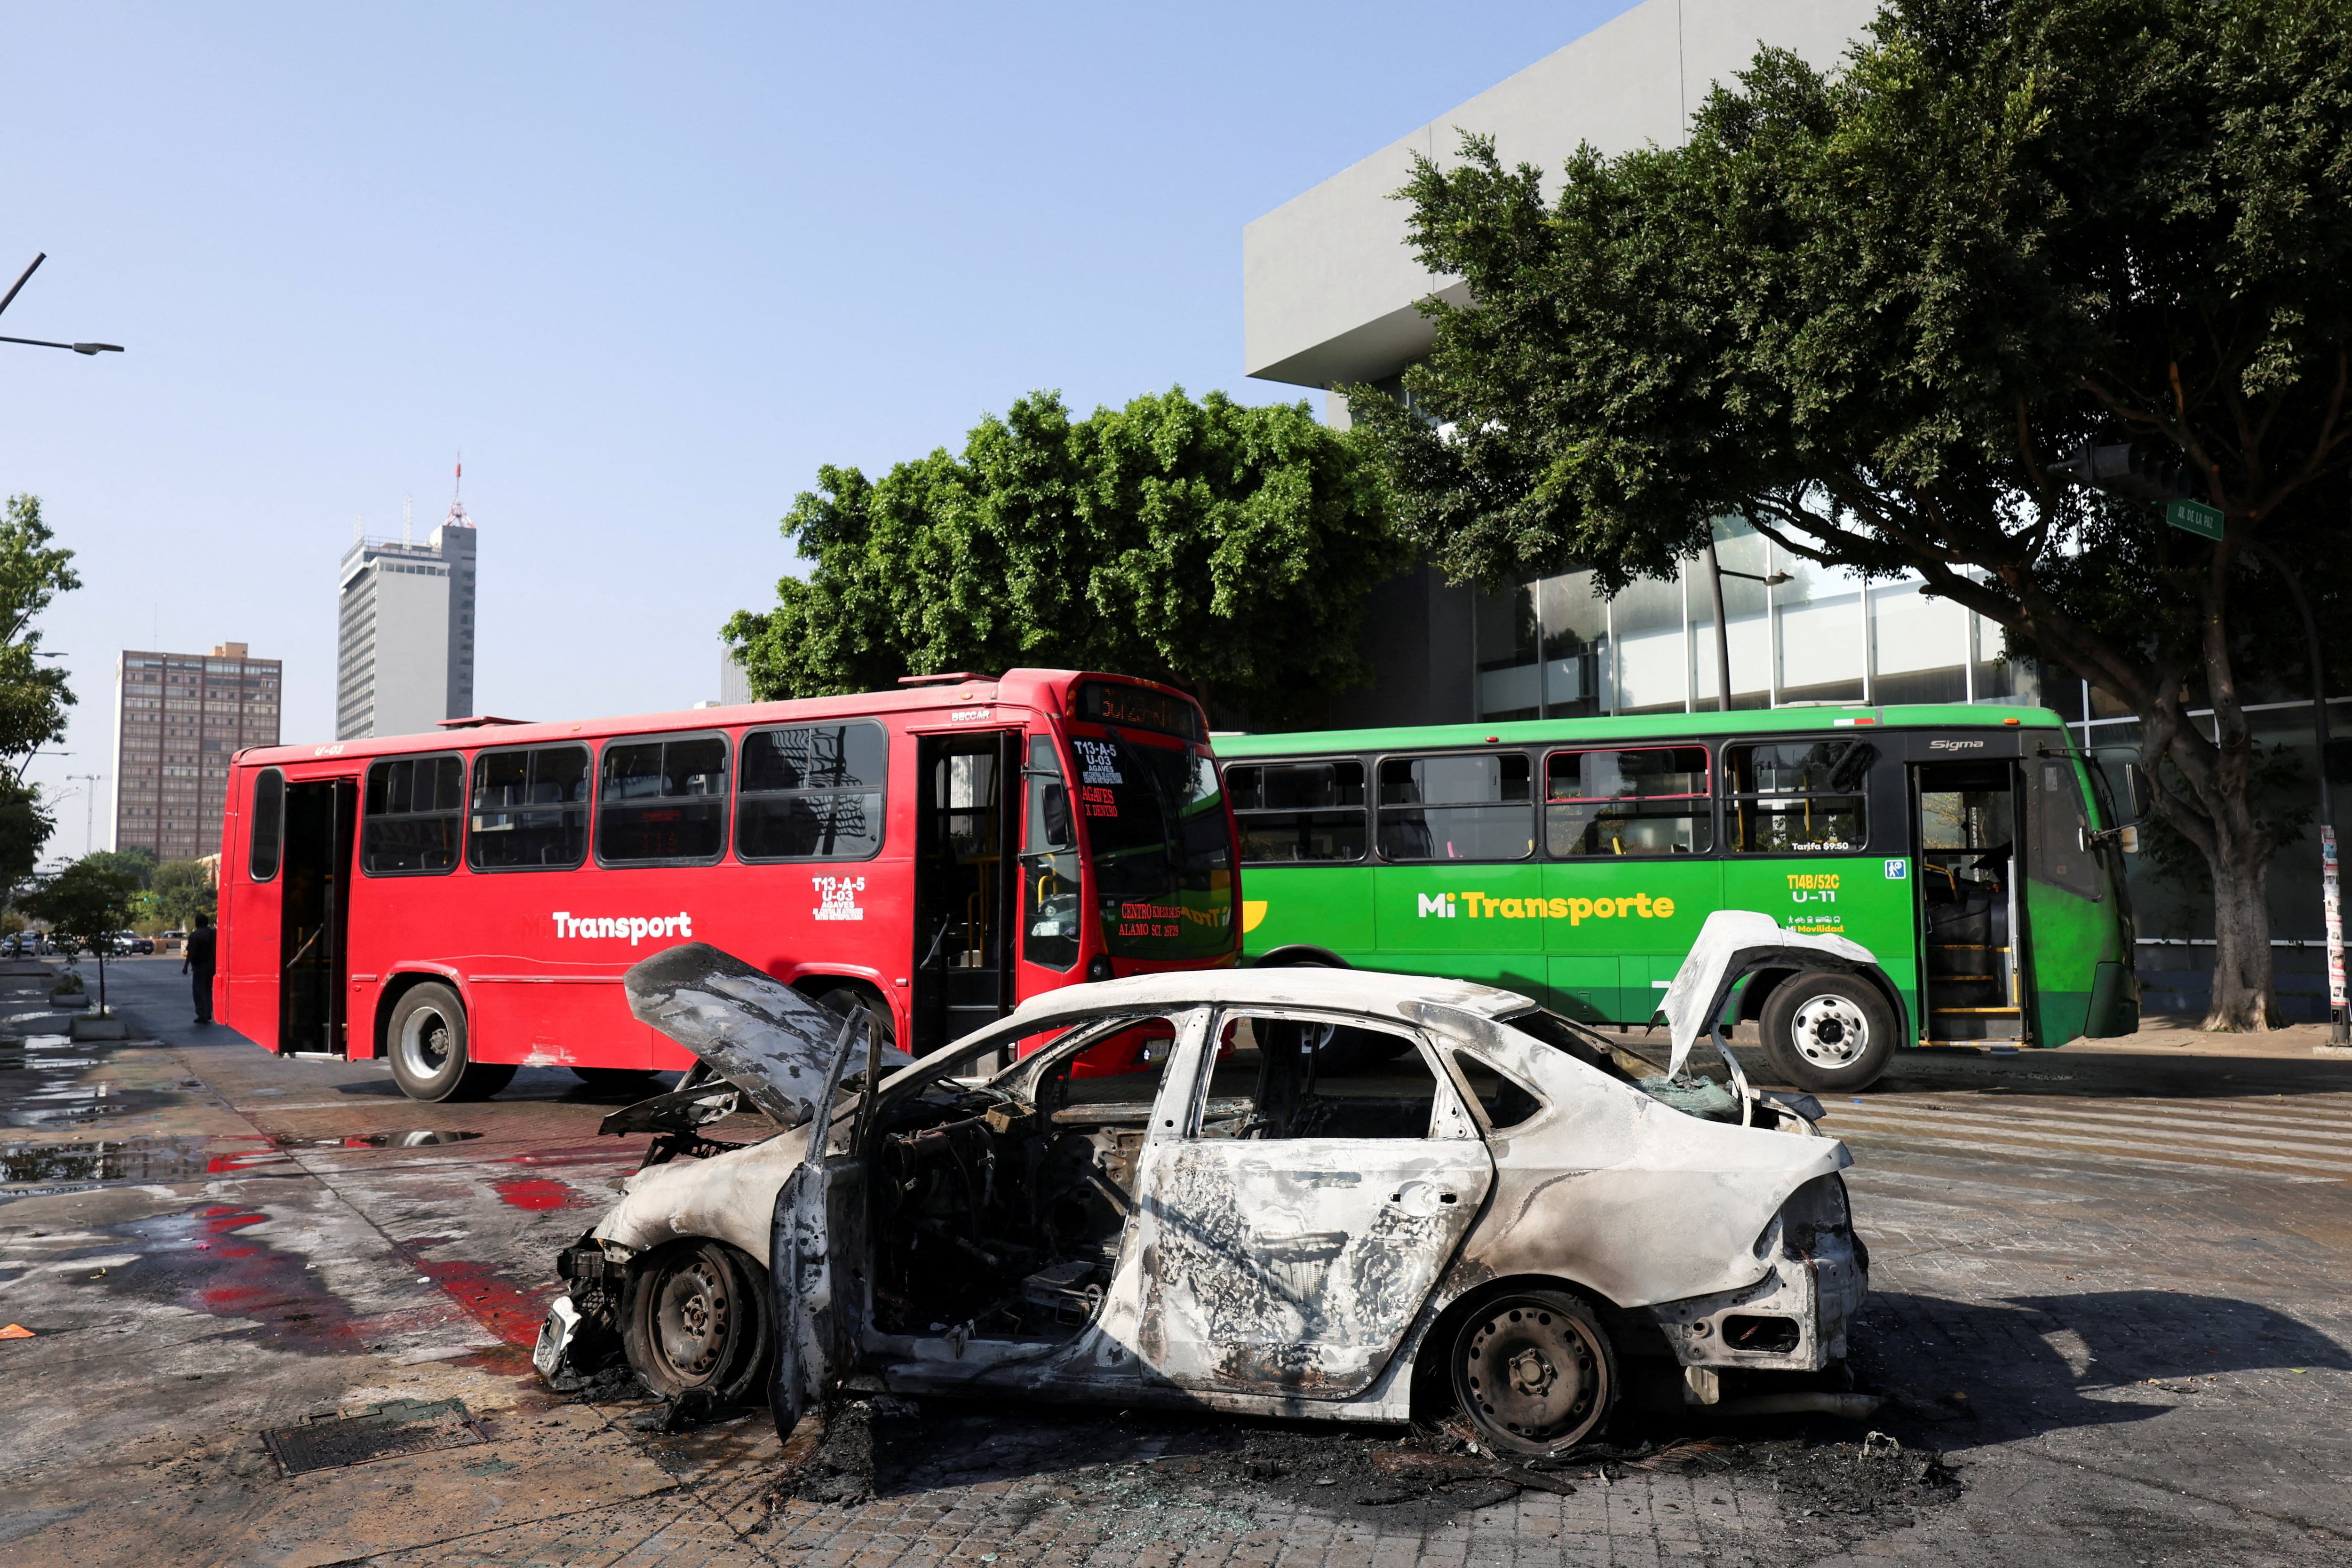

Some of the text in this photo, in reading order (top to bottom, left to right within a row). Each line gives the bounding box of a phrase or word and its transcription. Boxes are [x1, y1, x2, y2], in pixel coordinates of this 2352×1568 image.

[2187, 508, 2194, 523] DE
[2196, 512, 2202, 525] LA
[2204, 515, 2213, 529] PAZ
[952, 710, 990, 721] BECCAR
[314, 744, 344, 756] U-03
[1074, 741, 1117, 757] T13-A-5
[1930, 740, 1984, 751] Sigma
[1086, 754, 1112, 766] U-03
[1082, 785, 1114, 804] AGAVES
[1085, 804, 1118, 817] X DENTRO
[1823, 842, 1849, 850] $9.50
[812, 877, 865, 891] T13-A-5
[1787, 874, 1840, 889] T14B/52C
[822, 890, 854, 901] U-03
[1792, 891, 1836, 903] U-11
[1121, 903, 1152, 919] CENTRO
[1418, 892, 1675, 926] Mi Transporte
[552, 911, 692, 946] Transport
[1119, 924, 1149, 935] ALAMO
